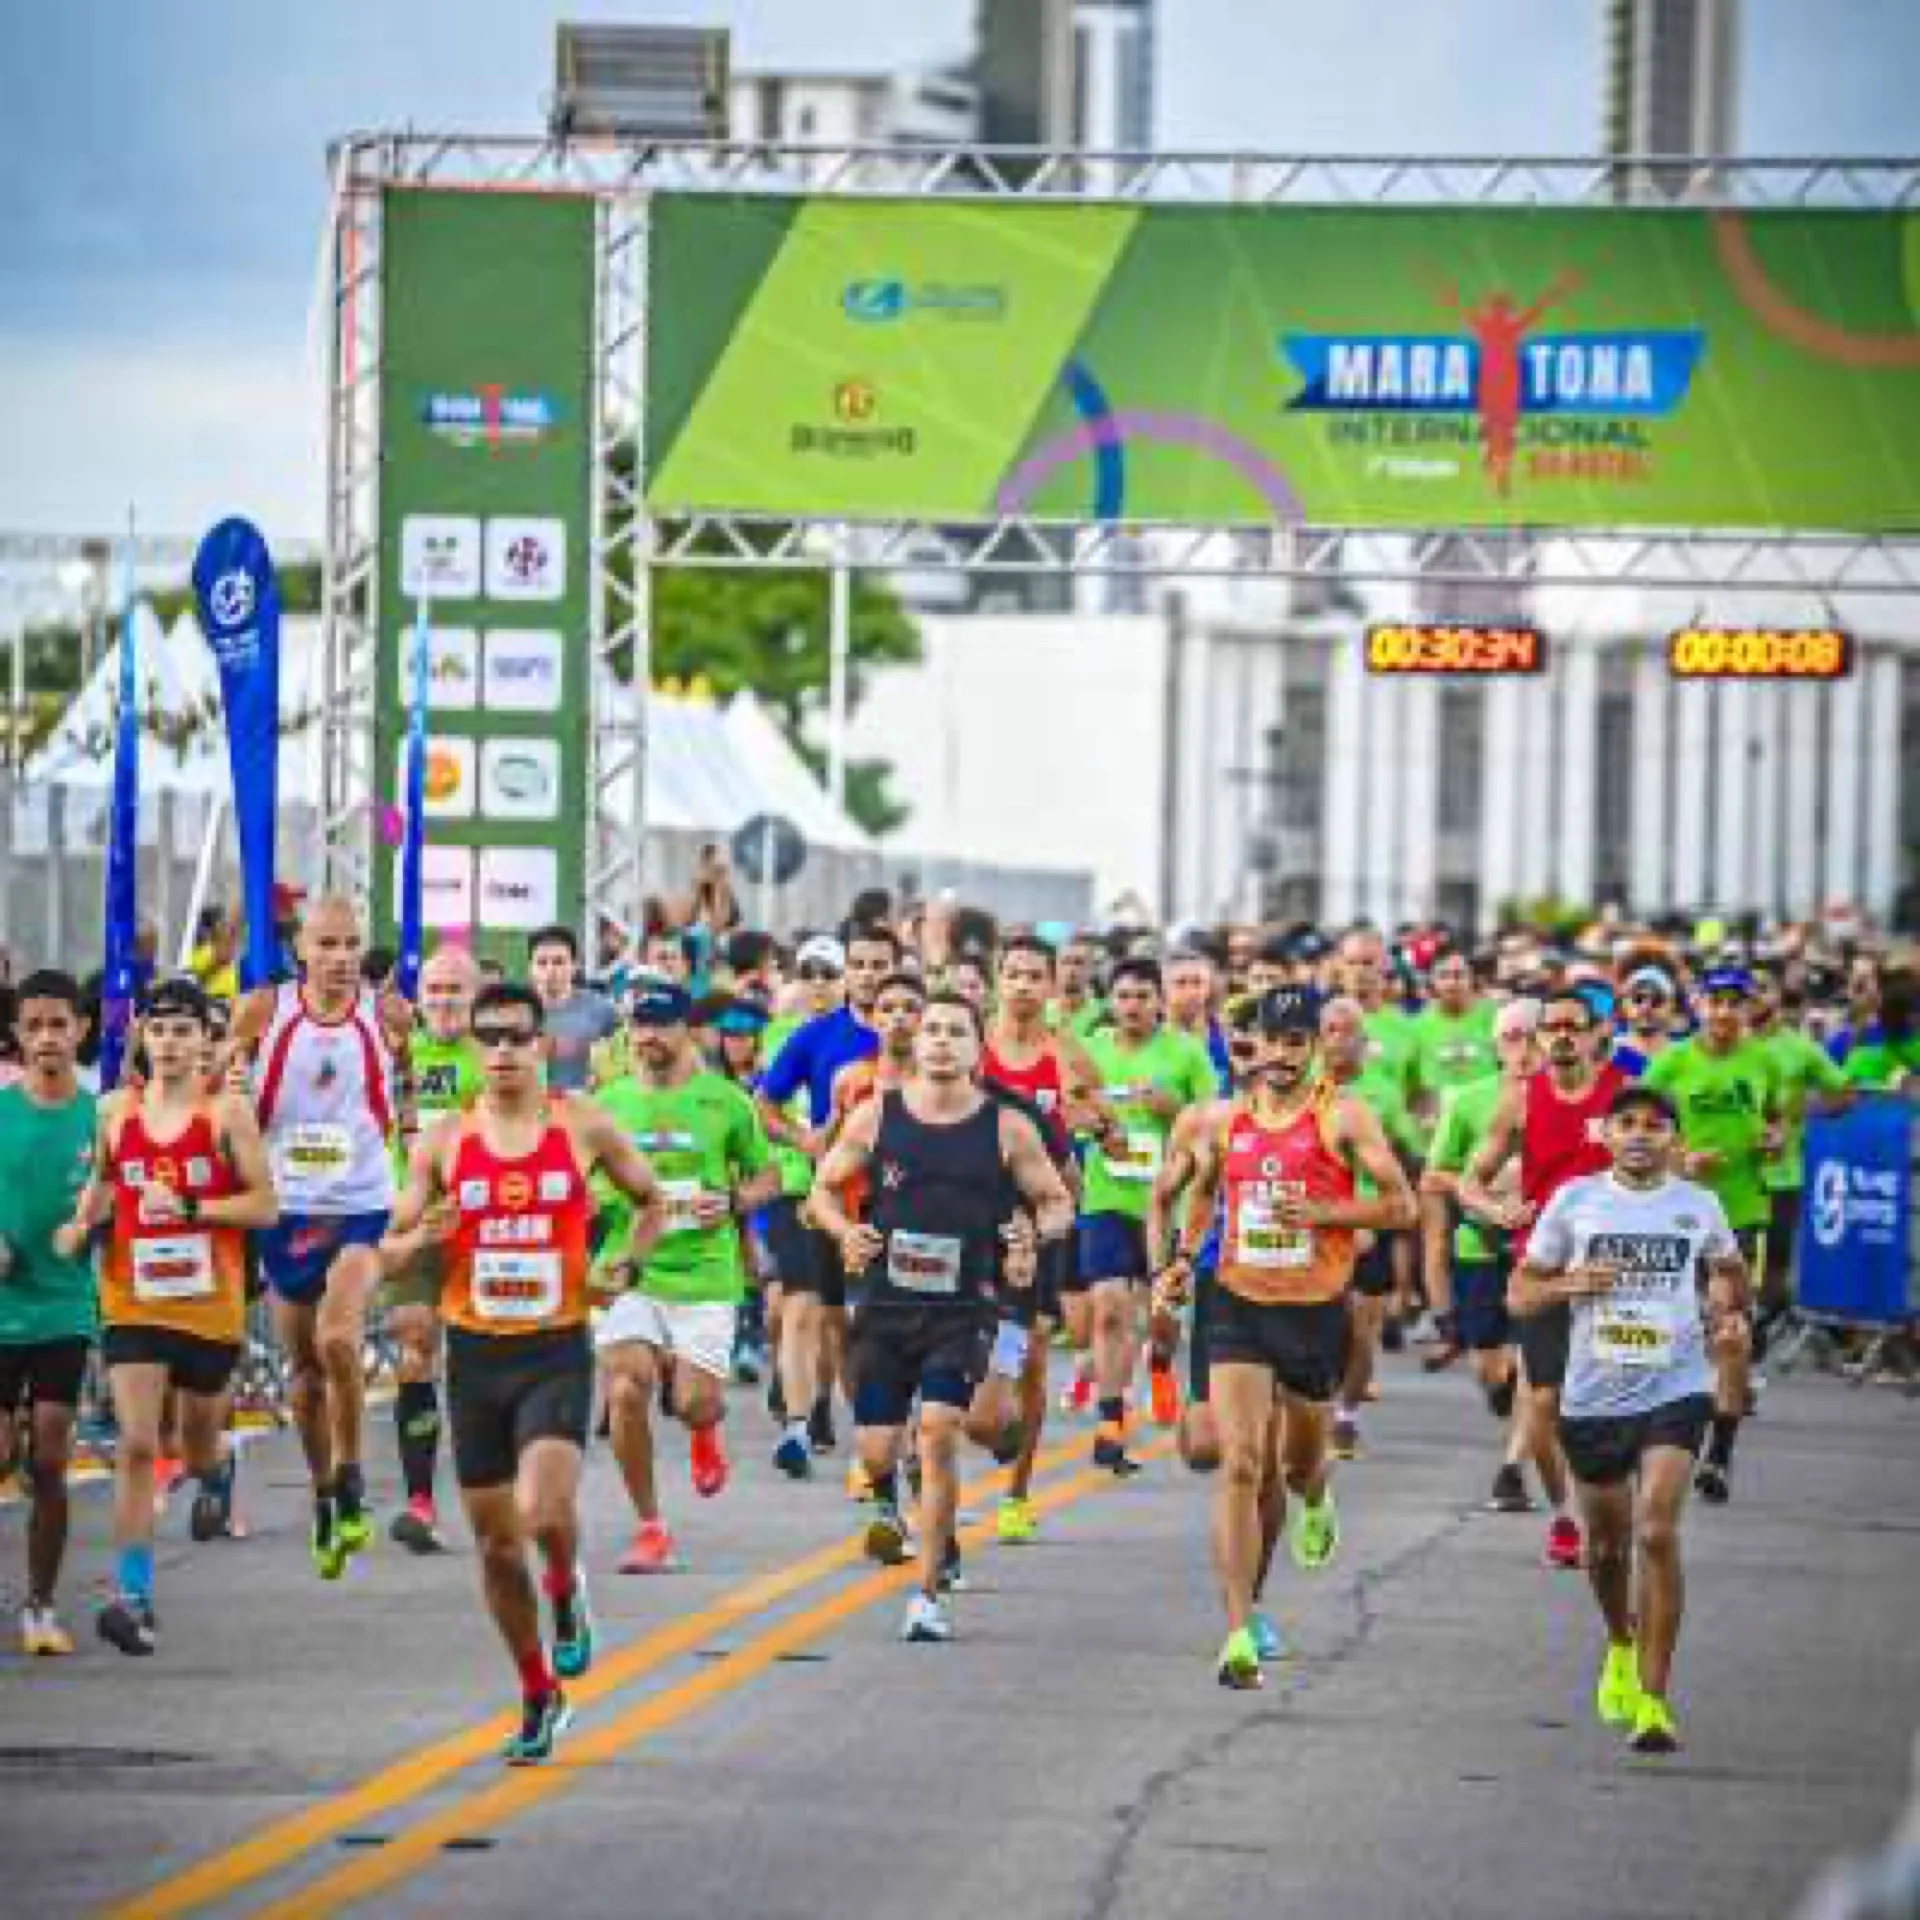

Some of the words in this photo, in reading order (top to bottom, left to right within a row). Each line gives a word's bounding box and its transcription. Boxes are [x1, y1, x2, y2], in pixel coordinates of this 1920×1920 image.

[1328, 344, 1469, 400] MARA
[1529, 344, 1653, 400] TONA
[1370, 629, 1534, 670] 00:30:34
